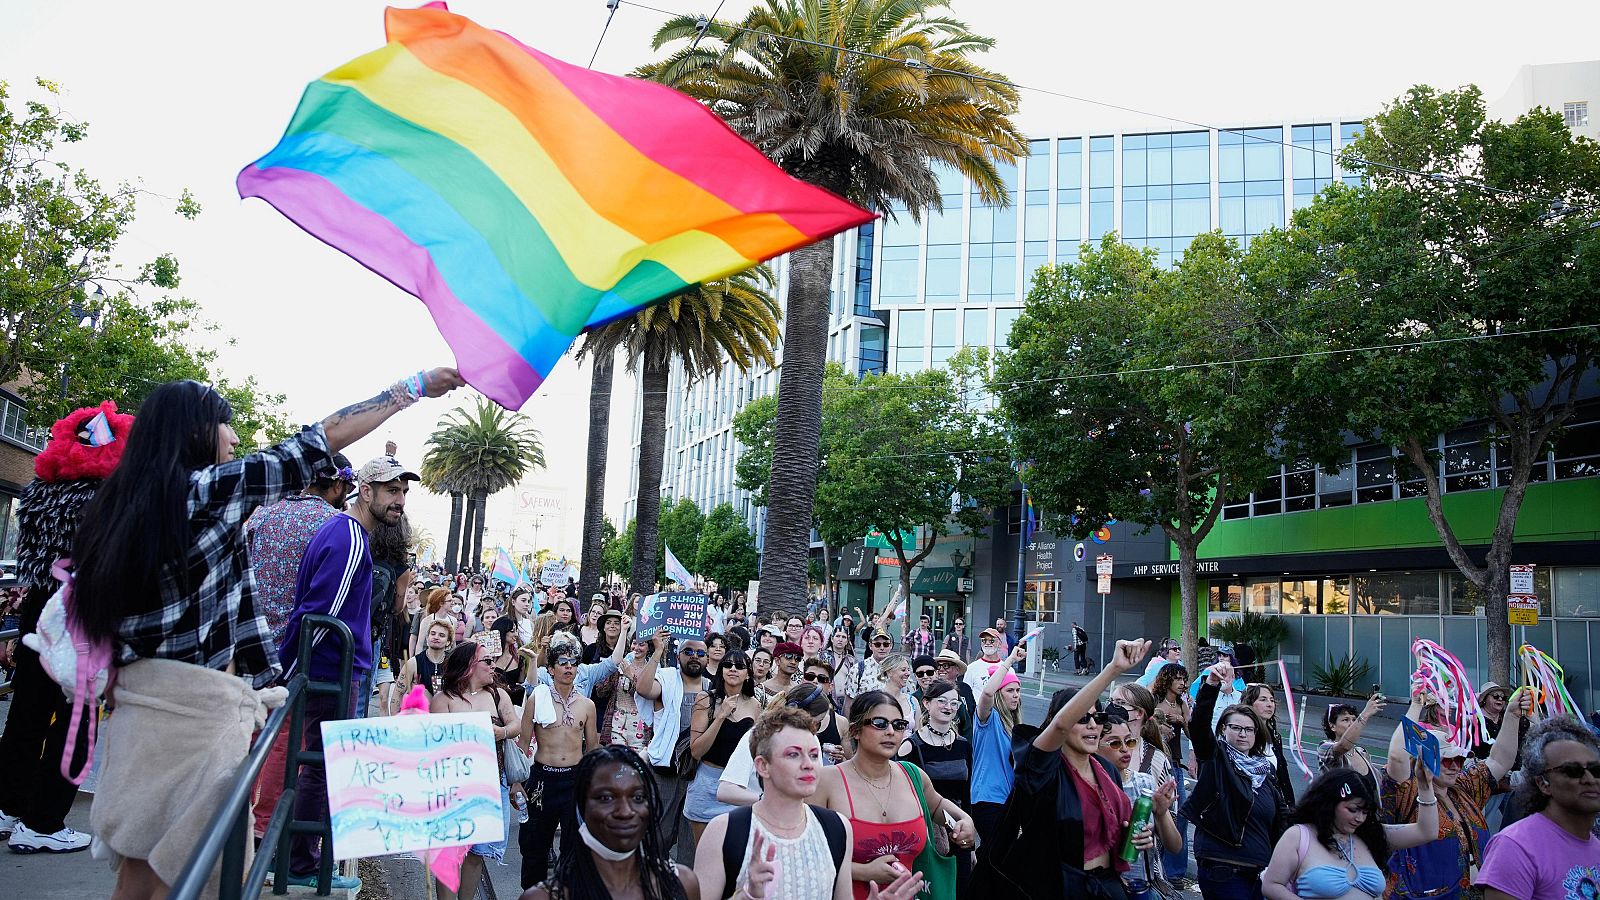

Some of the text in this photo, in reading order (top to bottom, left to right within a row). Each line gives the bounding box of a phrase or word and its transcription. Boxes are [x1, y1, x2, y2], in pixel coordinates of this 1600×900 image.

[519, 491, 561, 509] SAFEWAY
[1036, 542, 1056, 550] Alliance
[1036, 551, 1053, 560] Health
[1036, 561, 1053, 571] Project
[1133, 565, 1148, 575] AHP
[1151, 563, 1180, 575] SERVICE
[670, 595, 705, 604] RIGHTS
[670, 602, 704, 612] HUMAN
[684, 611, 704, 619] ARE
[666, 617, 702, 628] RIGHTS
[347, 756, 473, 788] ARE GIFTS
[375, 785, 463, 814] TO THE
